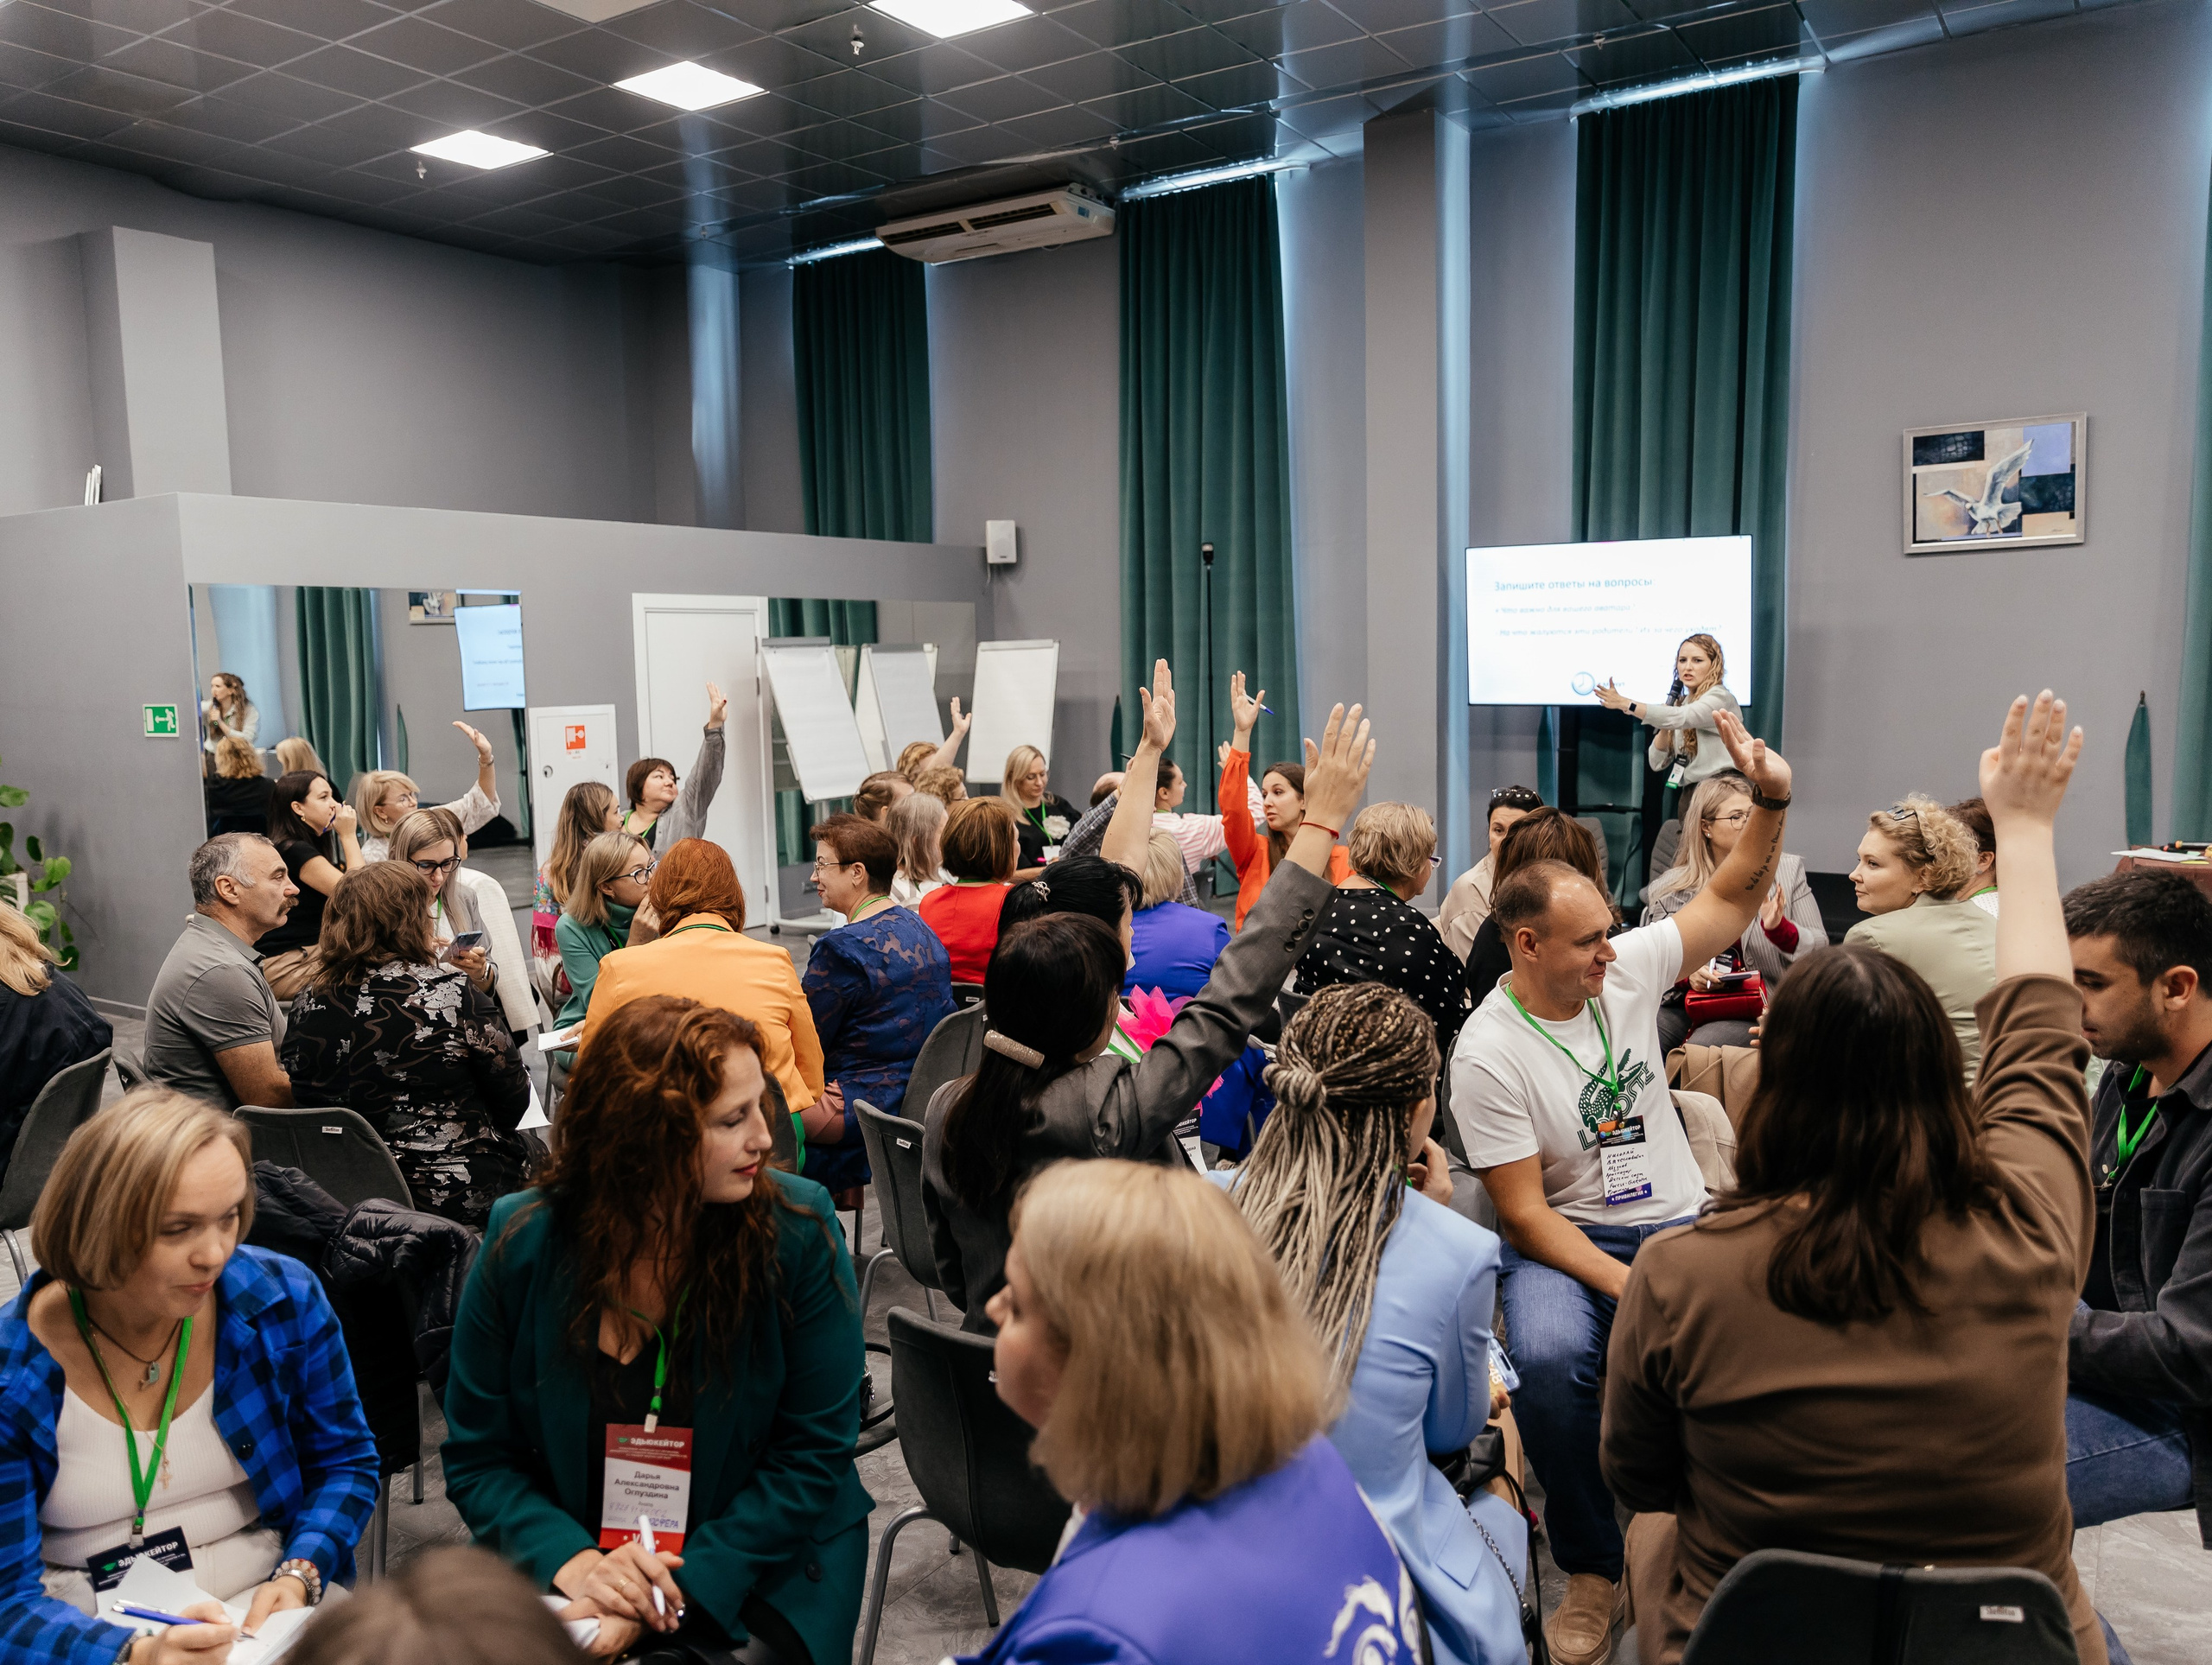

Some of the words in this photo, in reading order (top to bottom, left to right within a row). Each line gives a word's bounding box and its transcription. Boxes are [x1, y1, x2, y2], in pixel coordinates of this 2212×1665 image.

[1495, 581, 1546, 592] Запишите
[1548, 580, 1586, 589] ответы
[1588, 580, 1601, 588] на
[1577, 1059, 1656, 1152] LOSTE
[630, 1437, 685, 1448] ЭДЬЮКЕЙТОР
[634, 1471, 661, 1480] Дарья
[614, 1478, 680, 1491] Александровна
[625, 1488, 669, 1499] Оглуздина
[632, 1517, 678, 1528] АОСФЕРА
